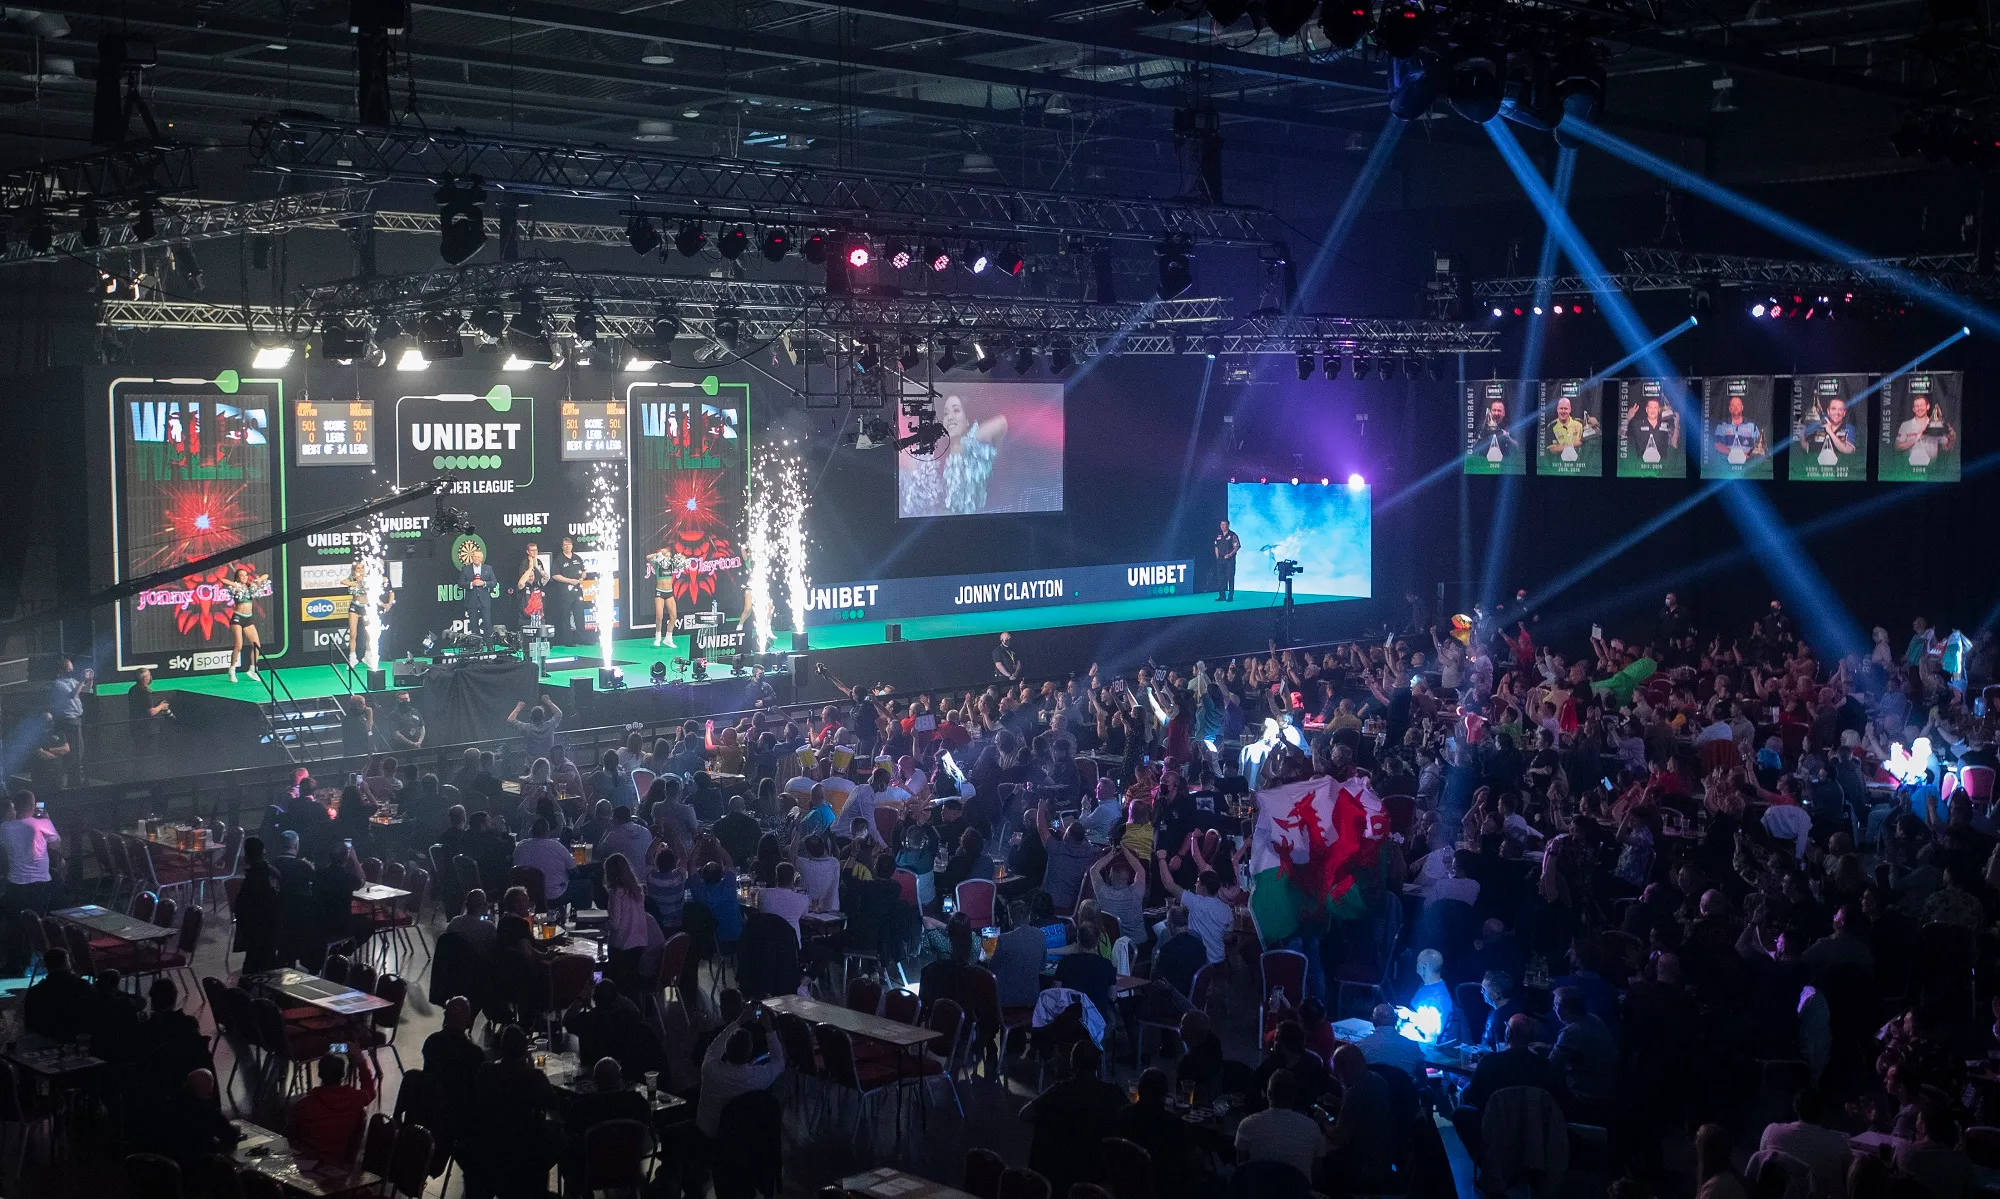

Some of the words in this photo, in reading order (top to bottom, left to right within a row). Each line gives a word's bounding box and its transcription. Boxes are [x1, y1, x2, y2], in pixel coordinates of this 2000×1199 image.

[1794, 379, 1802, 416] TAYLOR
[1883, 377, 1891, 406] WADE
[302, 420, 317, 432] 501
[323, 420, 347, 432] SCORE
[353, 420, 367, 432] 501
[566, 418, 579, 429] 501
[584, 418, 604, 429] SCORE
[609, 418, 621, 429] 501
[1882, 409, 1891, 444] JAMES
[308, 432, 315, 443] 0
[325, 432, 346, 443] LEGS
[355, 432, 362, 443] 0
[411, 423, 521, 451] UNIBET
[572, 429, 577, 440] 0
[586, 429, 602, 440] LEGS
[611, 429, 617, 439] 0
[301, 443, 322, 455] BEST
[323, 444, 335, 455] OF
[336, 444, 348, 455] 14
[349, 443, 369, 455] LEGS
[566, 440, 583, 451] BEST
[584, 440, 593, 450] OF
[605, 440, 622, 450] LEGS
[472, 479, 515, 494] LEAGUE
[380, 516, 430, 532] UNIBET
[503, 512, 549, 527] UNIBET
[307, 532, 359, 547] UNIBET
[689, 556, 742, 576] Clayton
[1127, 564, 1187, 587] UNIBET
[137, 589, 195, 611] Jonny
[437, 584, 466, 602] NIG
[803, 584, 879, 611] UNIBET
[954, 583, 1001, 605] JONNY
[1004, 579, 1063, 601] CLAYTON
[307, 602, 334, 614] selco
[697, 632, 745, 649] UNIBET
[168, 655, 193, 671] sky
[1154, 669, 1167, 681] 180
[1112, 679, 1124, 693] 180
